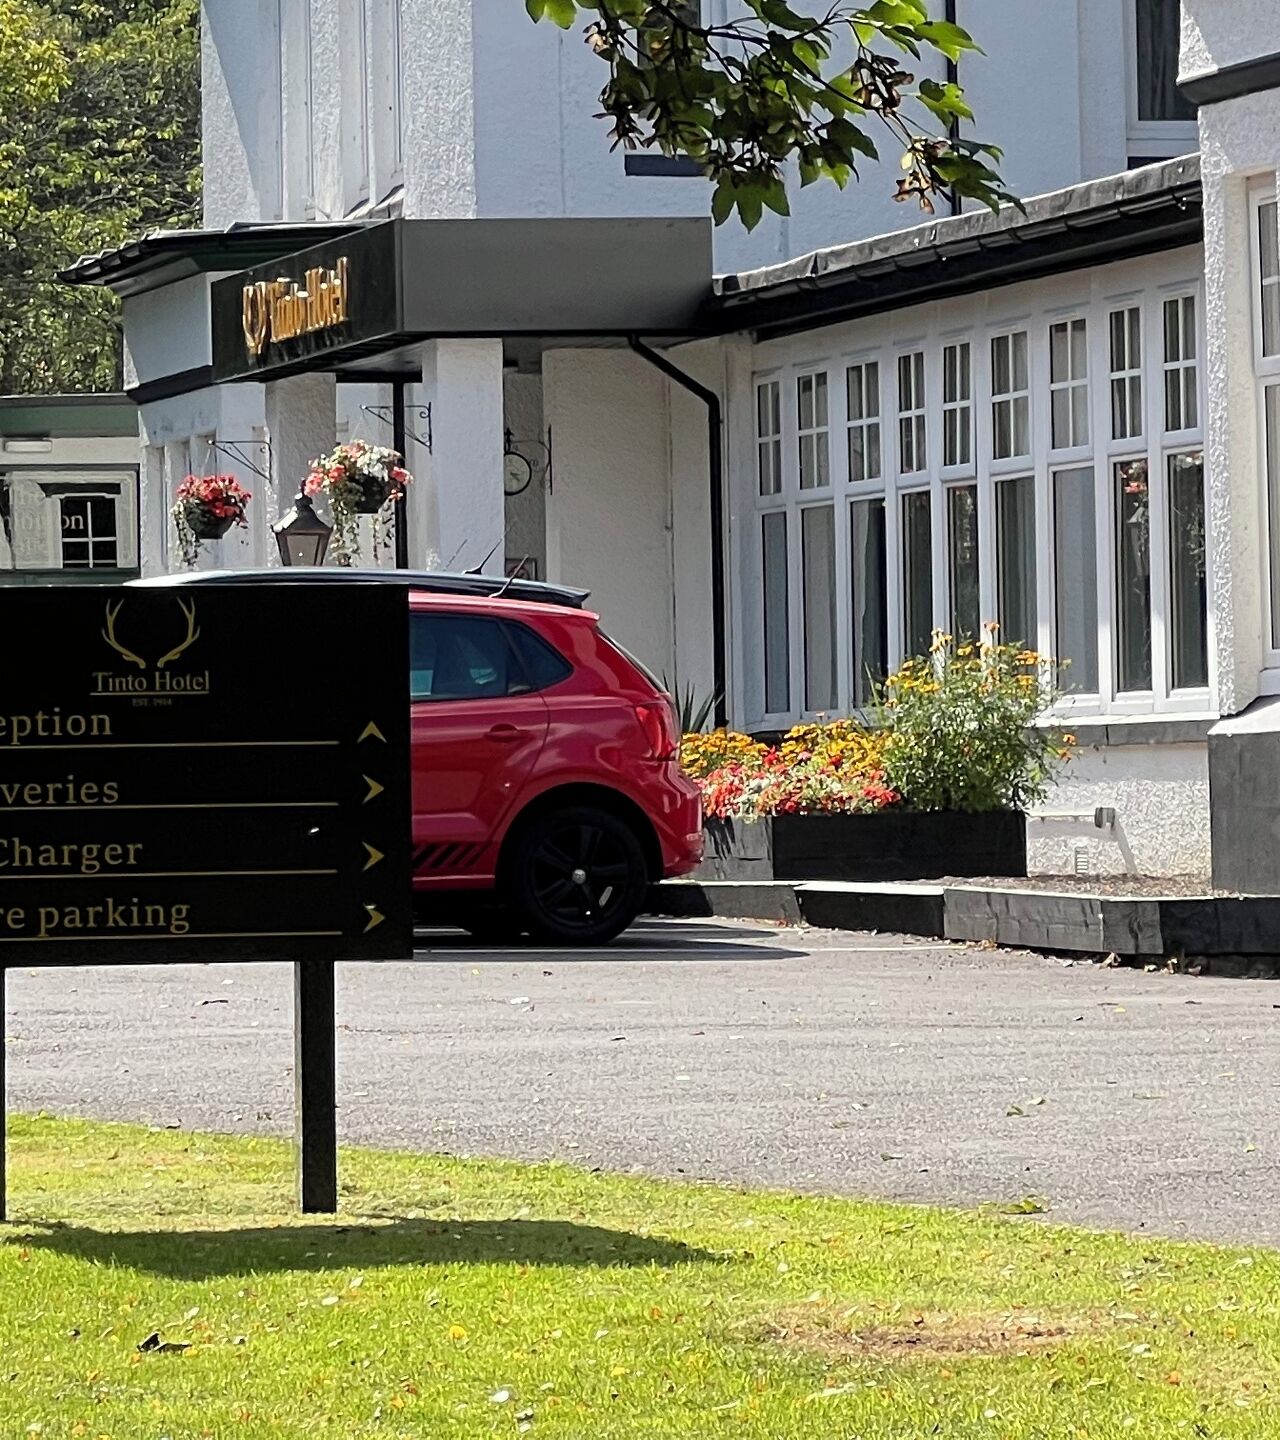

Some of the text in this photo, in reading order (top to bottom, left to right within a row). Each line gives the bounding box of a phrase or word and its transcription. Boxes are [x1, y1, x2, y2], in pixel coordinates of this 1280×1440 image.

[92, 670, 209, 692] Tinto Hotel
[39, 898, 191, 937] parking
